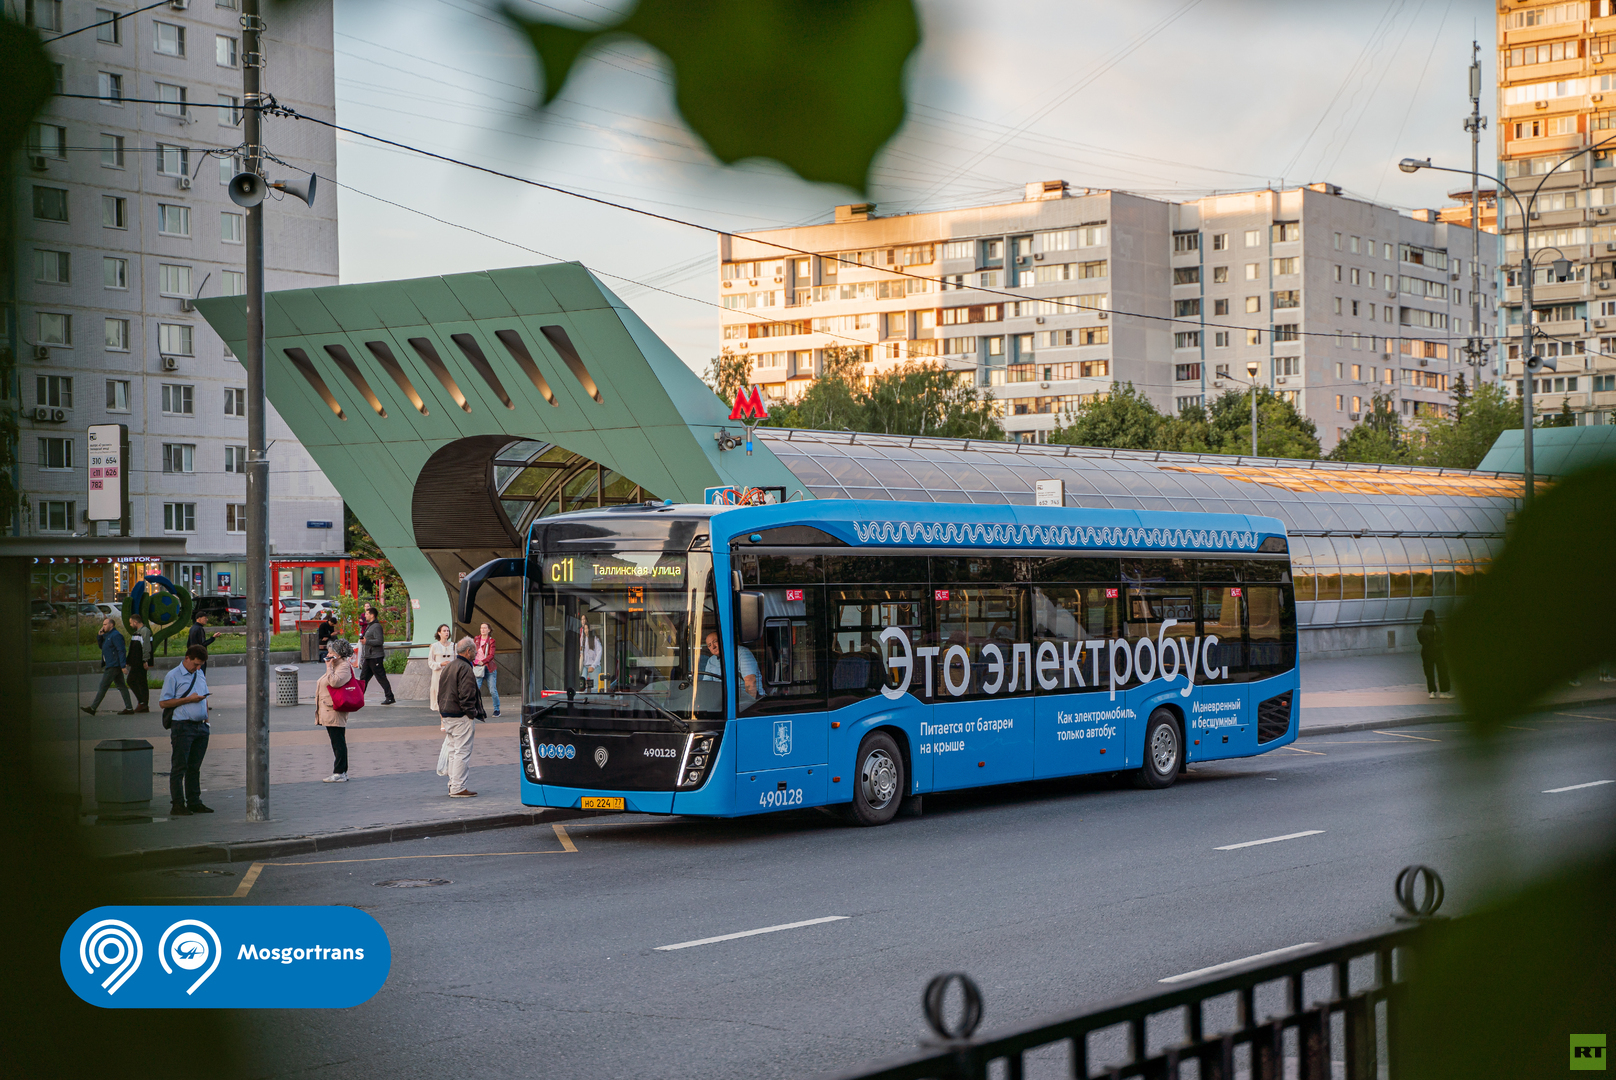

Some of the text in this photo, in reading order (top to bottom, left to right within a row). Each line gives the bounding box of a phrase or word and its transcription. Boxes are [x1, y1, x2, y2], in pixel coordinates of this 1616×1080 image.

[728, 385, 769, 419] М
[92, 457, 102, 465] 310
[551, 558, 681, 582] с11 Таллинская улица
[879, 619, 1229, 701] Это электробус.
[1192, 698, 1241, 714] Маневренный
[1057, 706, 1137, 725] Как электромобиль,
[1192, 714, 1238, 730] и бесшумный
[920, 717, 1013, 736] Питается от батареи
[1057, 725, 1117, 741] только автобус
[643, 748, 677, 758] 490128
[920, 740, 965, 756] на крыше
[596, 798, 611, 808] 224
[759, 788, 803, 808] 490128
